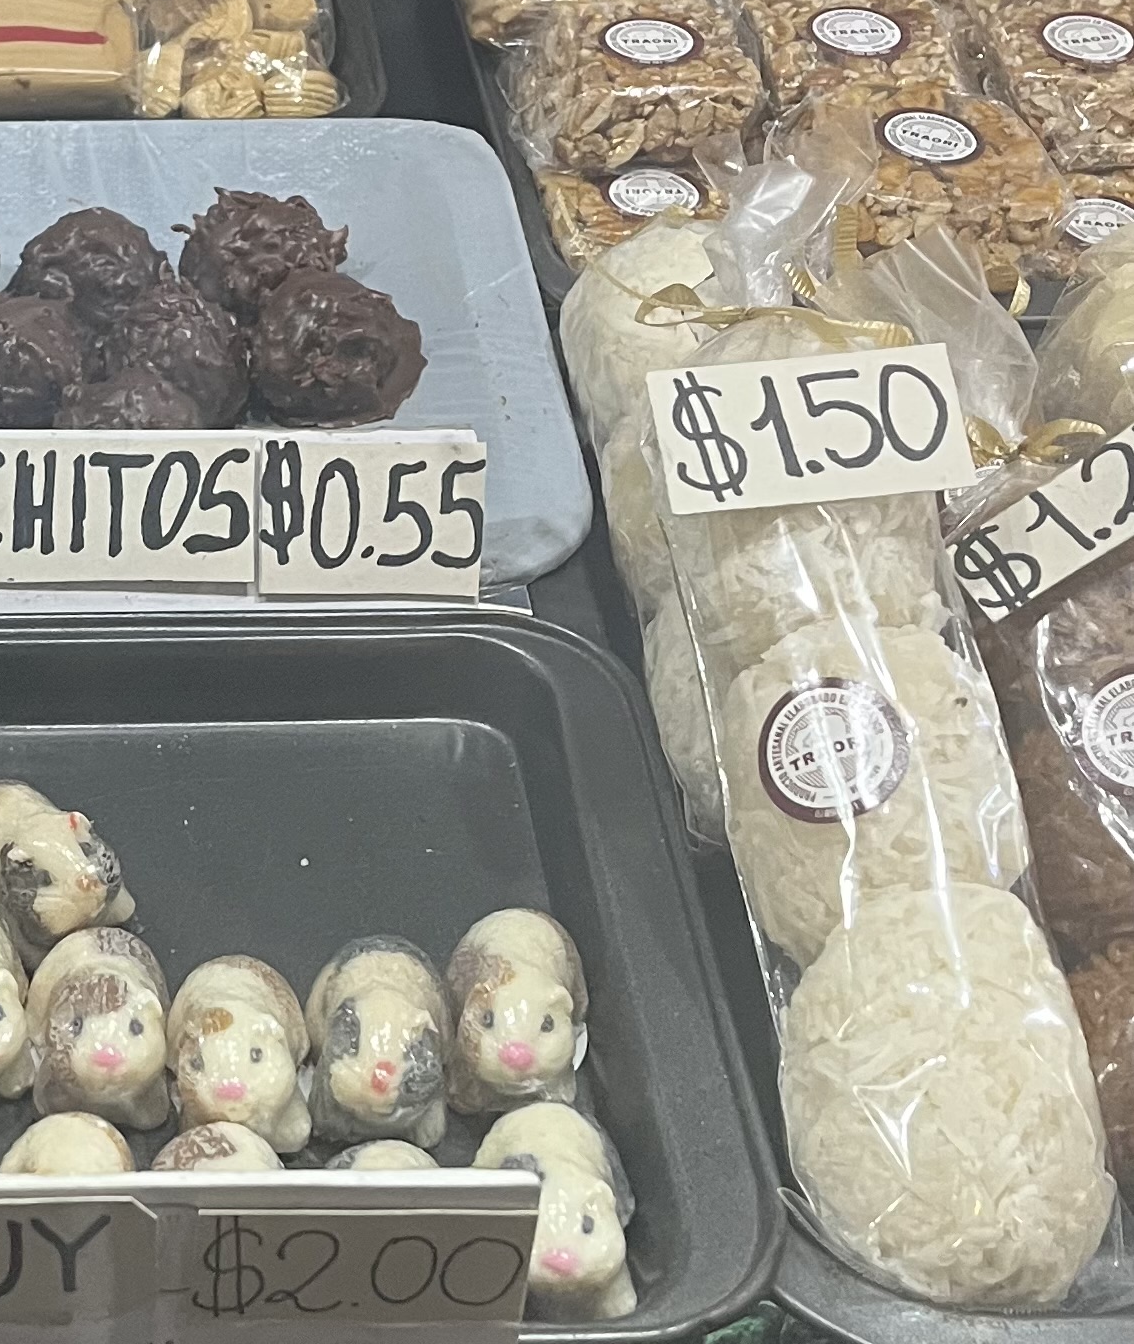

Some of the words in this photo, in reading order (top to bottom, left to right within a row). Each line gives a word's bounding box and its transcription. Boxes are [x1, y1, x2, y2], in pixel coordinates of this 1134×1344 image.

[830, 27, 886, 36] TRAORI
[1063, 34, 1117, 45] TRAORI
[672, 363, 948, 502] $1.50
[259, 440, 486, 569] $0.55
[192, 1214, 524, 1317] $2.00
